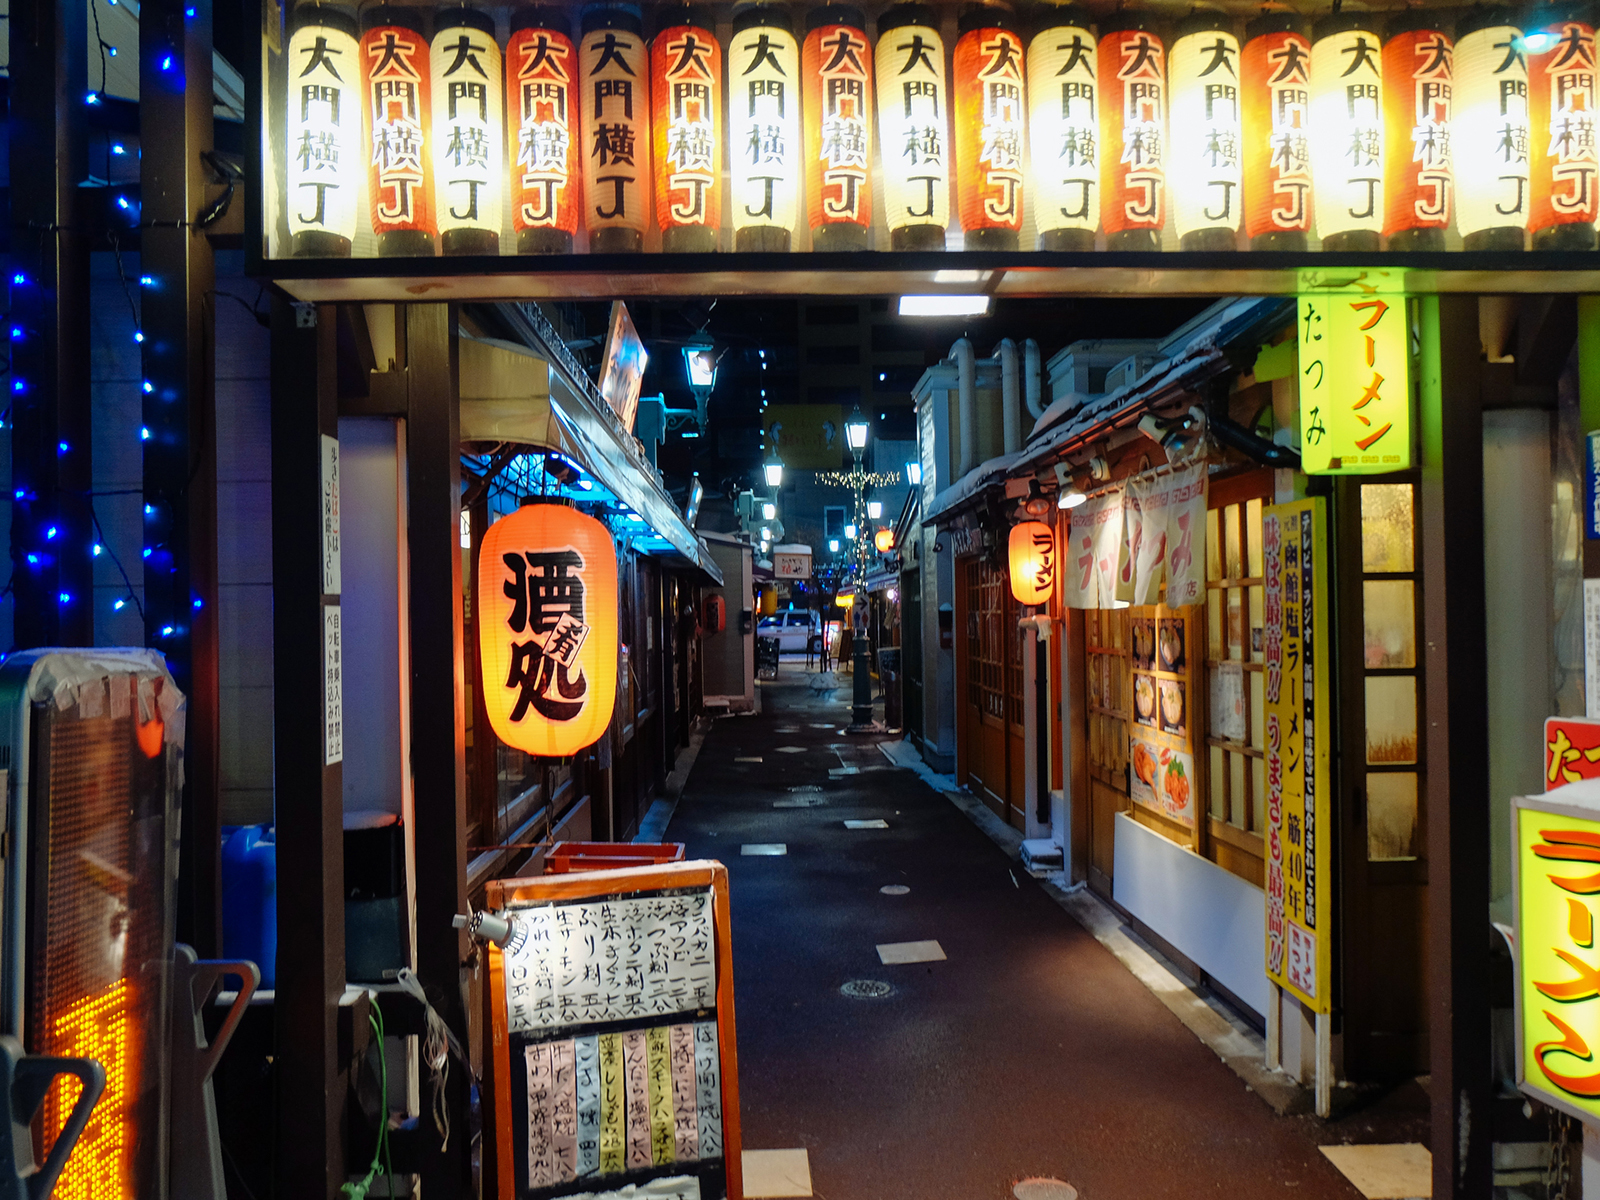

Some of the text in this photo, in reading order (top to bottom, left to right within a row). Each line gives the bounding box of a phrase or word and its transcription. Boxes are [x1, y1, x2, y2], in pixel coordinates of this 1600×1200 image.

[296, 36, 342, 225] 大門横丁
[371, 32, 418, 224] 大門横丁
[443, 36, 491, 222] 大門横丁
[517, 31, 569, 226] 大門横丁
[589, 33, 637, 222] 大門横丁
[663, 31, 716, 226] 大門横丁
[741, 34, 787, 221] 大門横丁
[817, 29, 871, 225] 大門横丁
[896, 35, 944, 219] 大門横丁
[979, 32, 1024, 225] 大門横丁
[1055, 35, 1098, 221] 大門横丁
[1118, 32, 1165, 224] 大門横丁
[1201, 37, 1241, 222] 大門横丁
[1266, 35, 1312, 229] 大門横丁
[1341, 37, 1383, 222] 大門横丁
[1413, 32, 1454, 225] 大門横丁
[1493, 34, 1528, 220] 大門横丁
[1544, 22, 1598, 224] 大門横丁
[1304, 302, 1326, 446] たつみ
[1349, 296, 1393, 450] ラーメン
[502, 549, 588, 722] 酒処
[1033, 533, 1053, 592] ラーメン
[327, 615, 335, 758] ペット持込み禁止
[333, 613, 341, 755] 自転車乗入れ禁止
